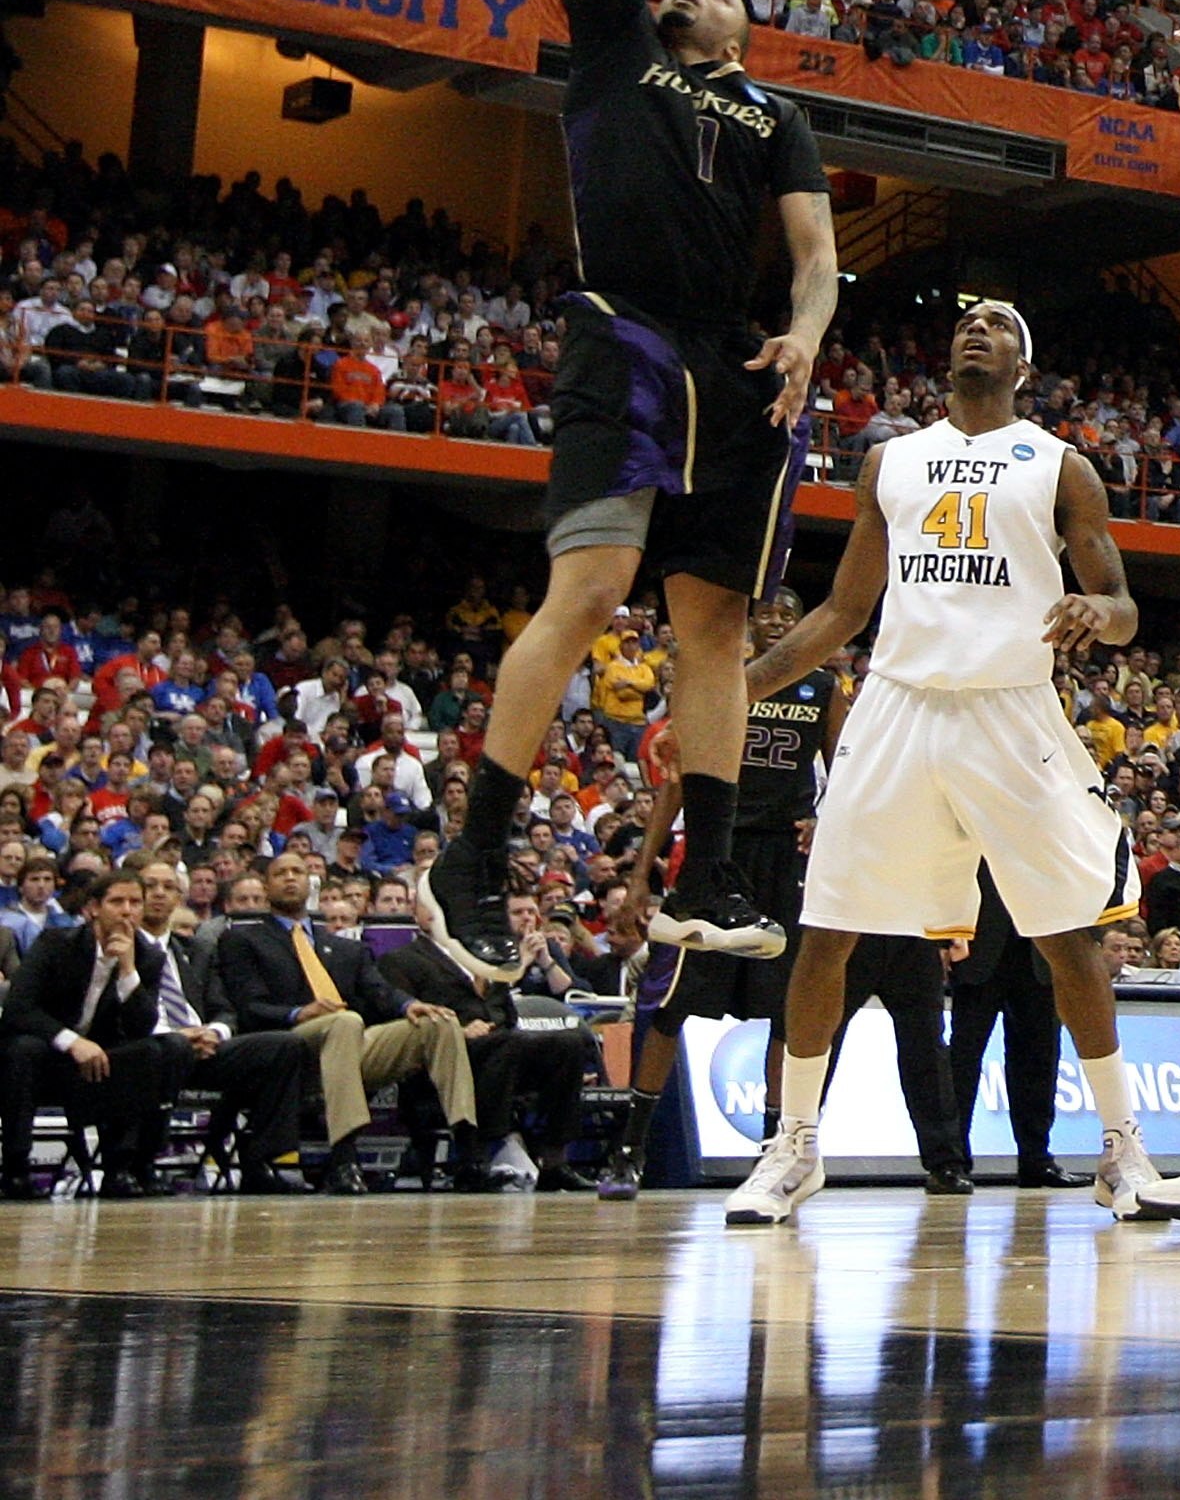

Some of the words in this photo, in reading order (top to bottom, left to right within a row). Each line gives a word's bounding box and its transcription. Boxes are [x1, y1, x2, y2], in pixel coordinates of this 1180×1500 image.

[799, 50, 837, 76] 212
[639, 63, 777, 138] HUSKIES
[1097, 115, 1156, 143] NCAA
[696, 116, 720, 183] 1
[926, 459, 1009, 485] WEST
[921, 491, 989, 549] 41
[898, 553, 1011, 587] VIRGINIA
[742, 725, 801, 770] 22
